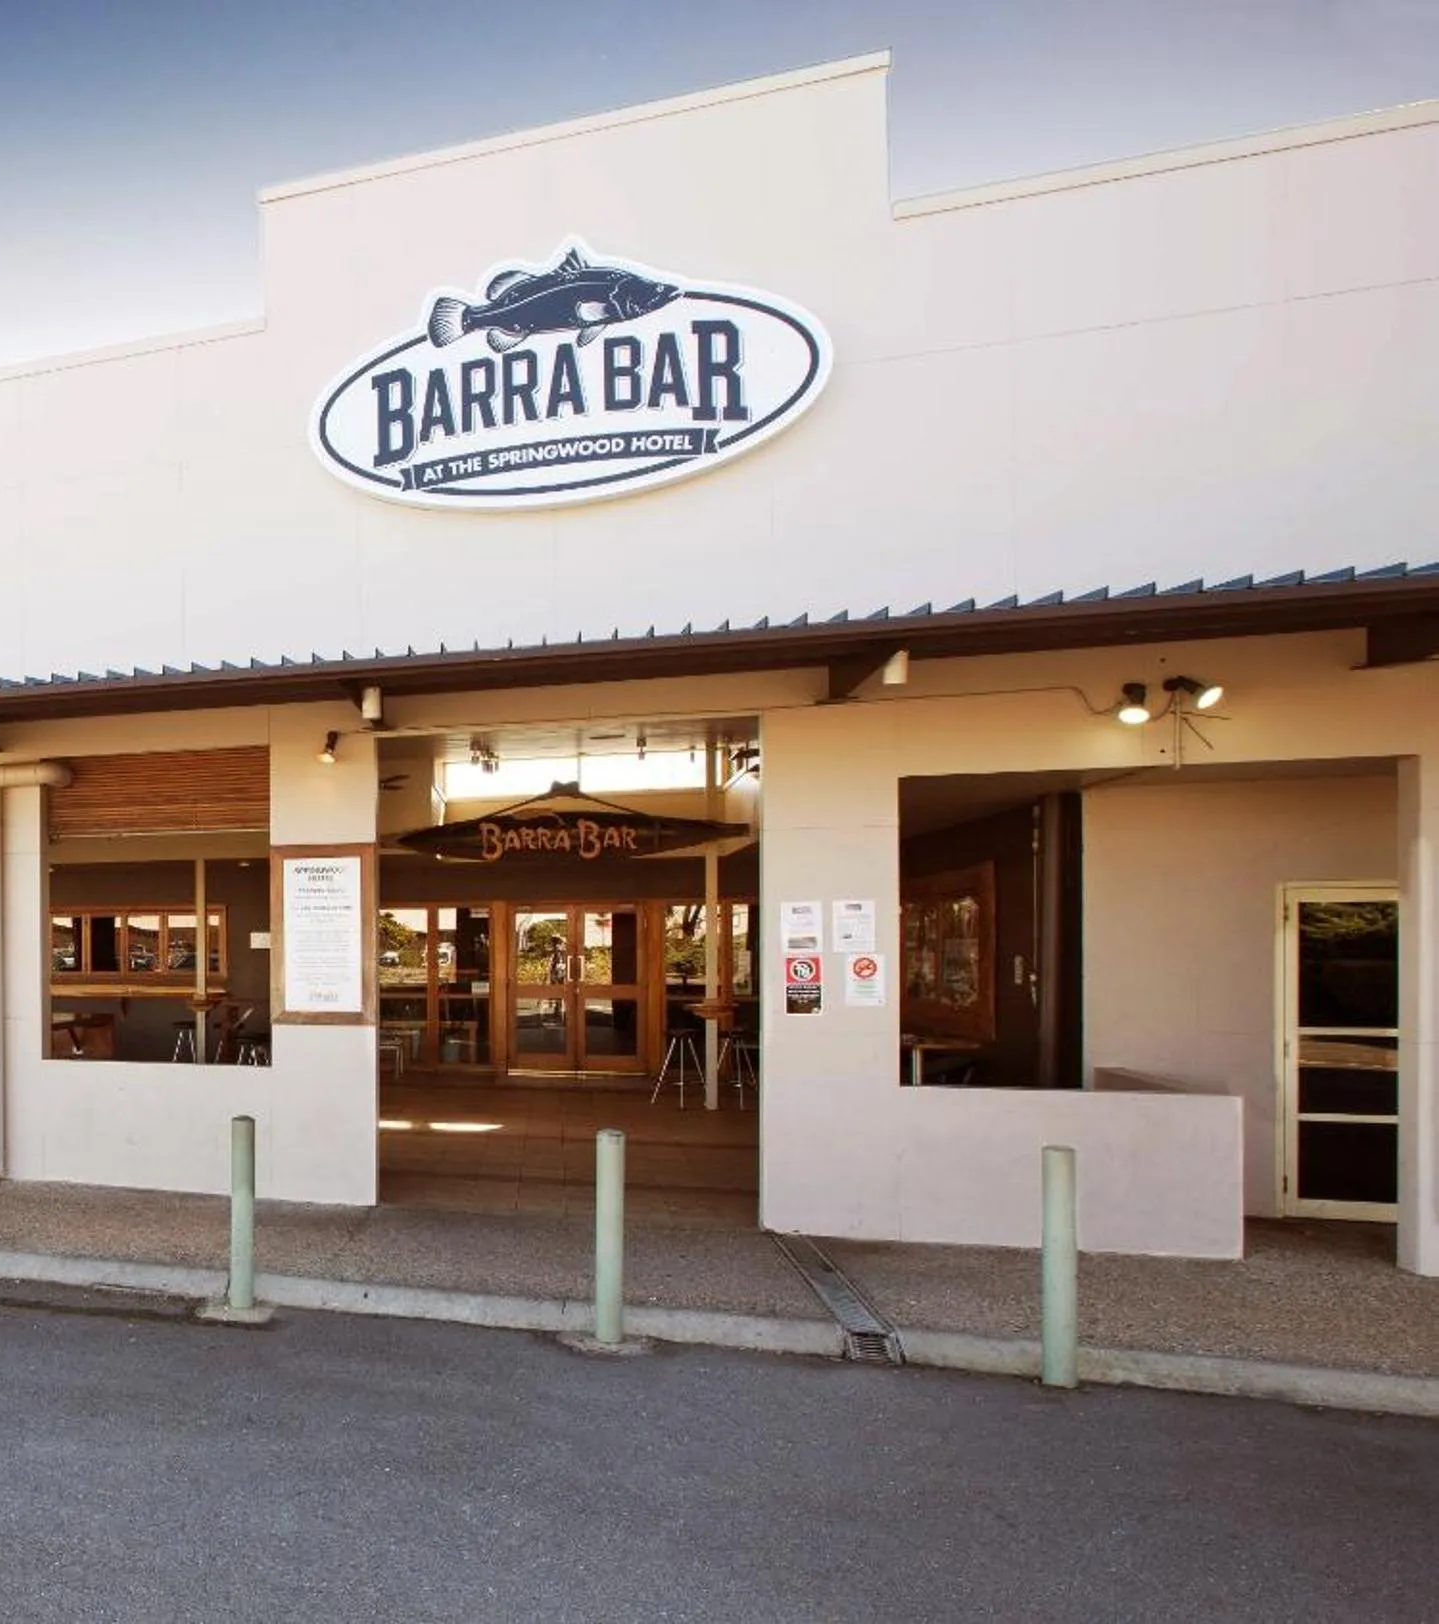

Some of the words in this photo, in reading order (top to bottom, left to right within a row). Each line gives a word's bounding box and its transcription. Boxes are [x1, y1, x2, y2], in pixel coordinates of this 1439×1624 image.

[371, 342, 586, 468] BARRA
[603, 319, 750, 424] BAR
[422, 465, 445, 483] AT
[448, 459, 483, 477] THE
[488, 436, 624, 468] SPRINGWOOD
[630, 434, 693, 452] HOTEL
[479, 821, 570, 859] BARRA
[577, 819, 638, 859] BAR
